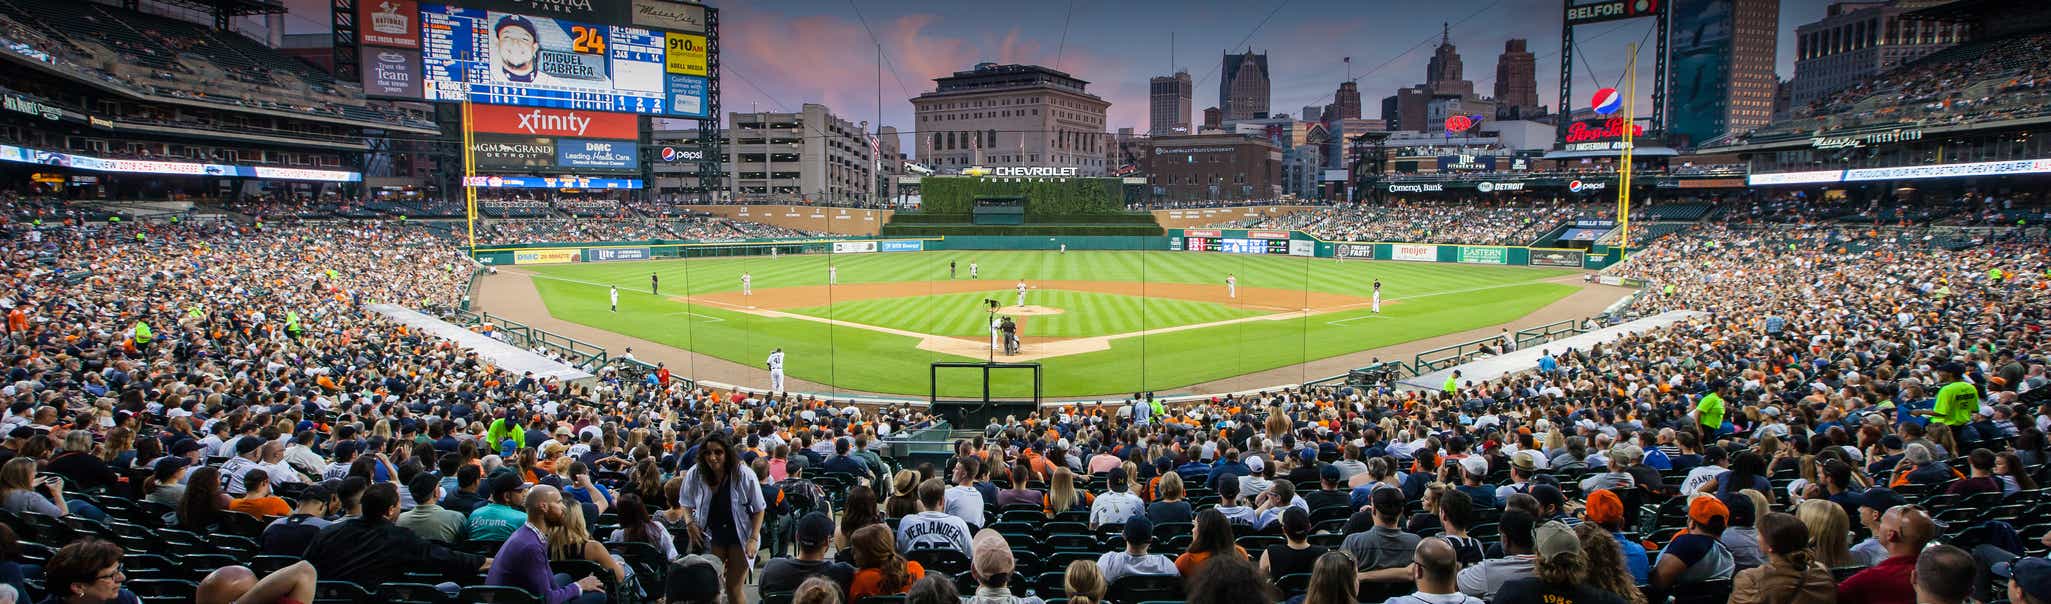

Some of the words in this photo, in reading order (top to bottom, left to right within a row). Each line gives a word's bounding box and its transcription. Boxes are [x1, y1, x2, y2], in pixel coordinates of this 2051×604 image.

[532, 2, 571, 13] PARK
[1567, 3, 1625, 20] BELFOR
[572, 26, 606, 54] 24
[542, 52, 584, 65] MIGUEL
[376, 67, 409, 80] Team
[543, 63, 594, 76] CABRERA
[518, 109, 591, 136] xfinity
[585, 142, 612, 152] DMC
[676, 151, 703, 160] pepsi
[996, 167, 1078, 176] CHEVROLET
[1423, 183, 1443, 191] Bank
[1582, 182, 1605, 191] pepsi
[1401, 247, 1427, 256] meijer
[904, 520, 961, 540] VERLANDER
